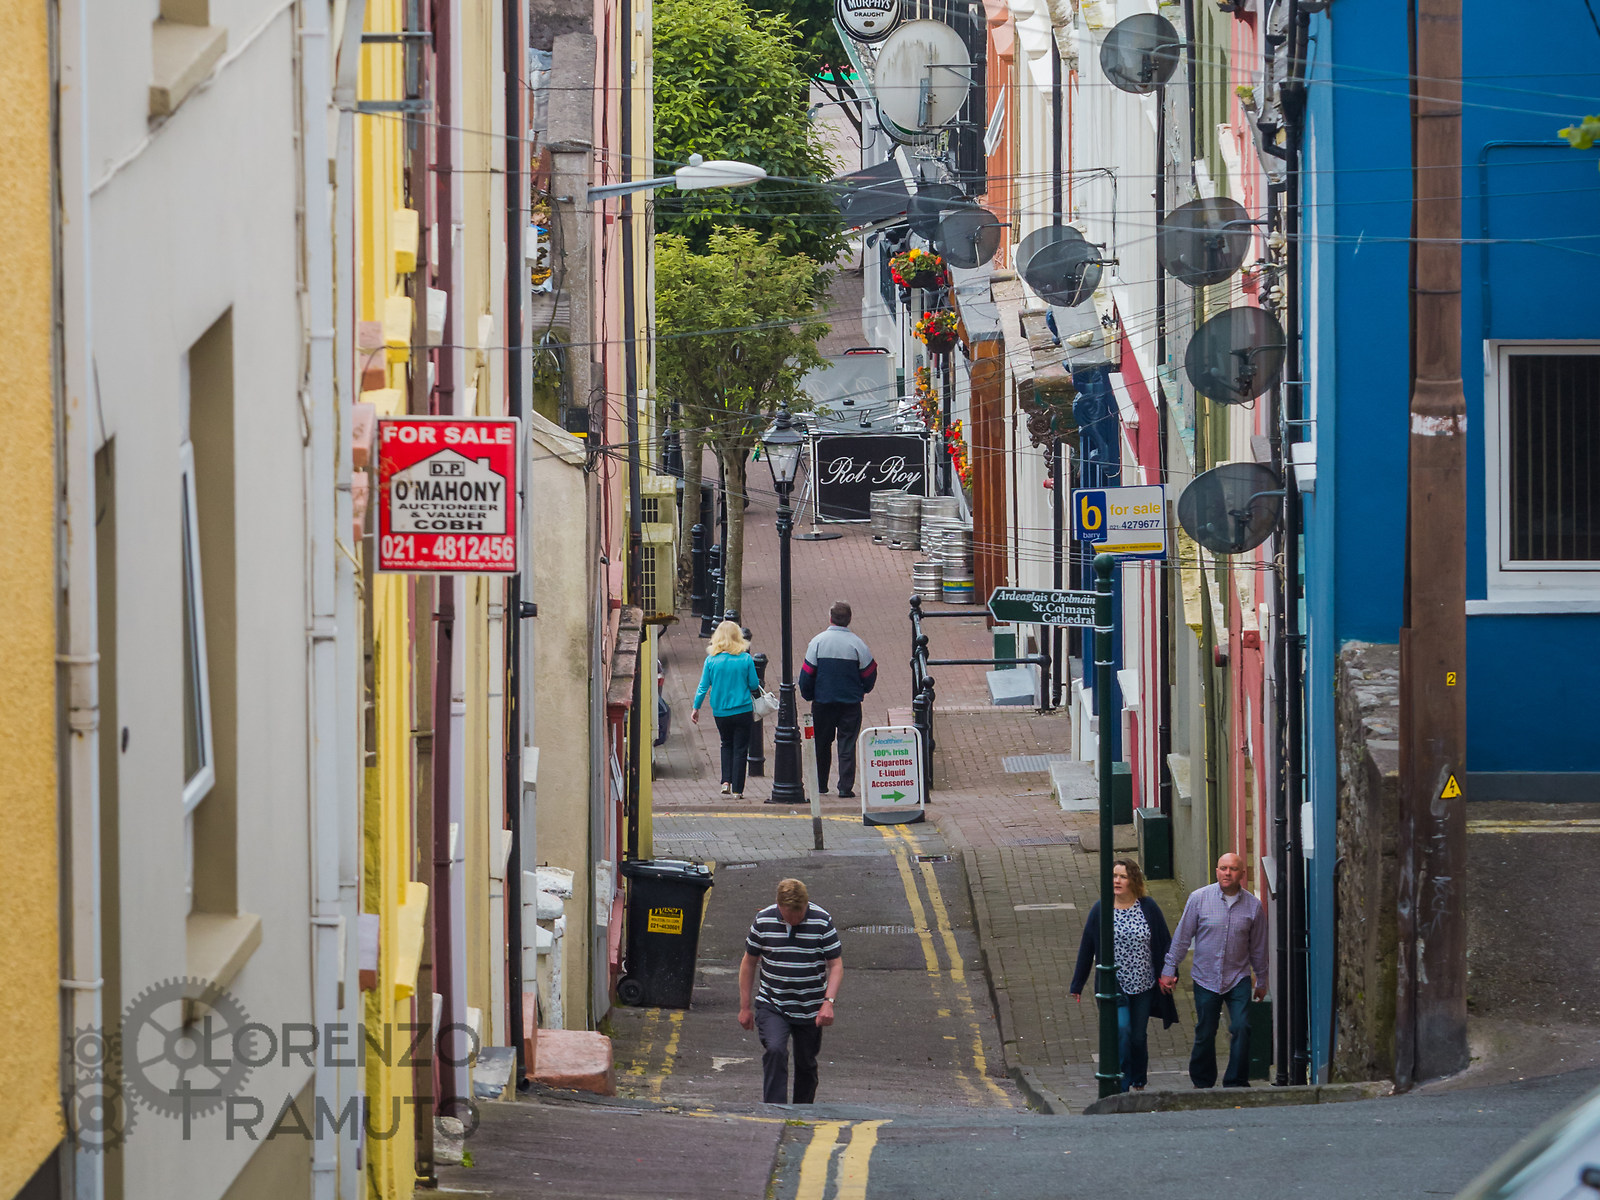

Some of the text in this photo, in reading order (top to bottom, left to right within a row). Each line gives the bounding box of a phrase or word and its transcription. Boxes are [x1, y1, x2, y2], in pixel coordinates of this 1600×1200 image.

[383, 426, 513, 445] FOR SALE
[432, 463, 463, 475] D.P.
[820, 455, 922, 491] Rob Roy
[395, 481, 501, 502] O'MAHONY
[398, 503, 499, 511] AUCTIONEER
[1081, 495, 1102, 530] b
[1110, 502, 1161, 516] for sale
[427, 511, 487, 519] VALUER
[414, 520, 484, 531] COBH
[381, 535, 415, 560] 021
[432, 536, 515, 561] 4812456
[383, 560, 514, 569] www.dpomahony.com
[997, 590, 1048, 603] Ardeaglais
[1042, 612, 1096, 625] Cathedral
[1448, 673, 1455, 684] 2
[873, 748, 909, 757] 100% Irish
[871, 759, 913, 768] E-Cigarettes
[879, 768, 906, 777] E-Liquid
[871, 779, 914, 788] Accessories
